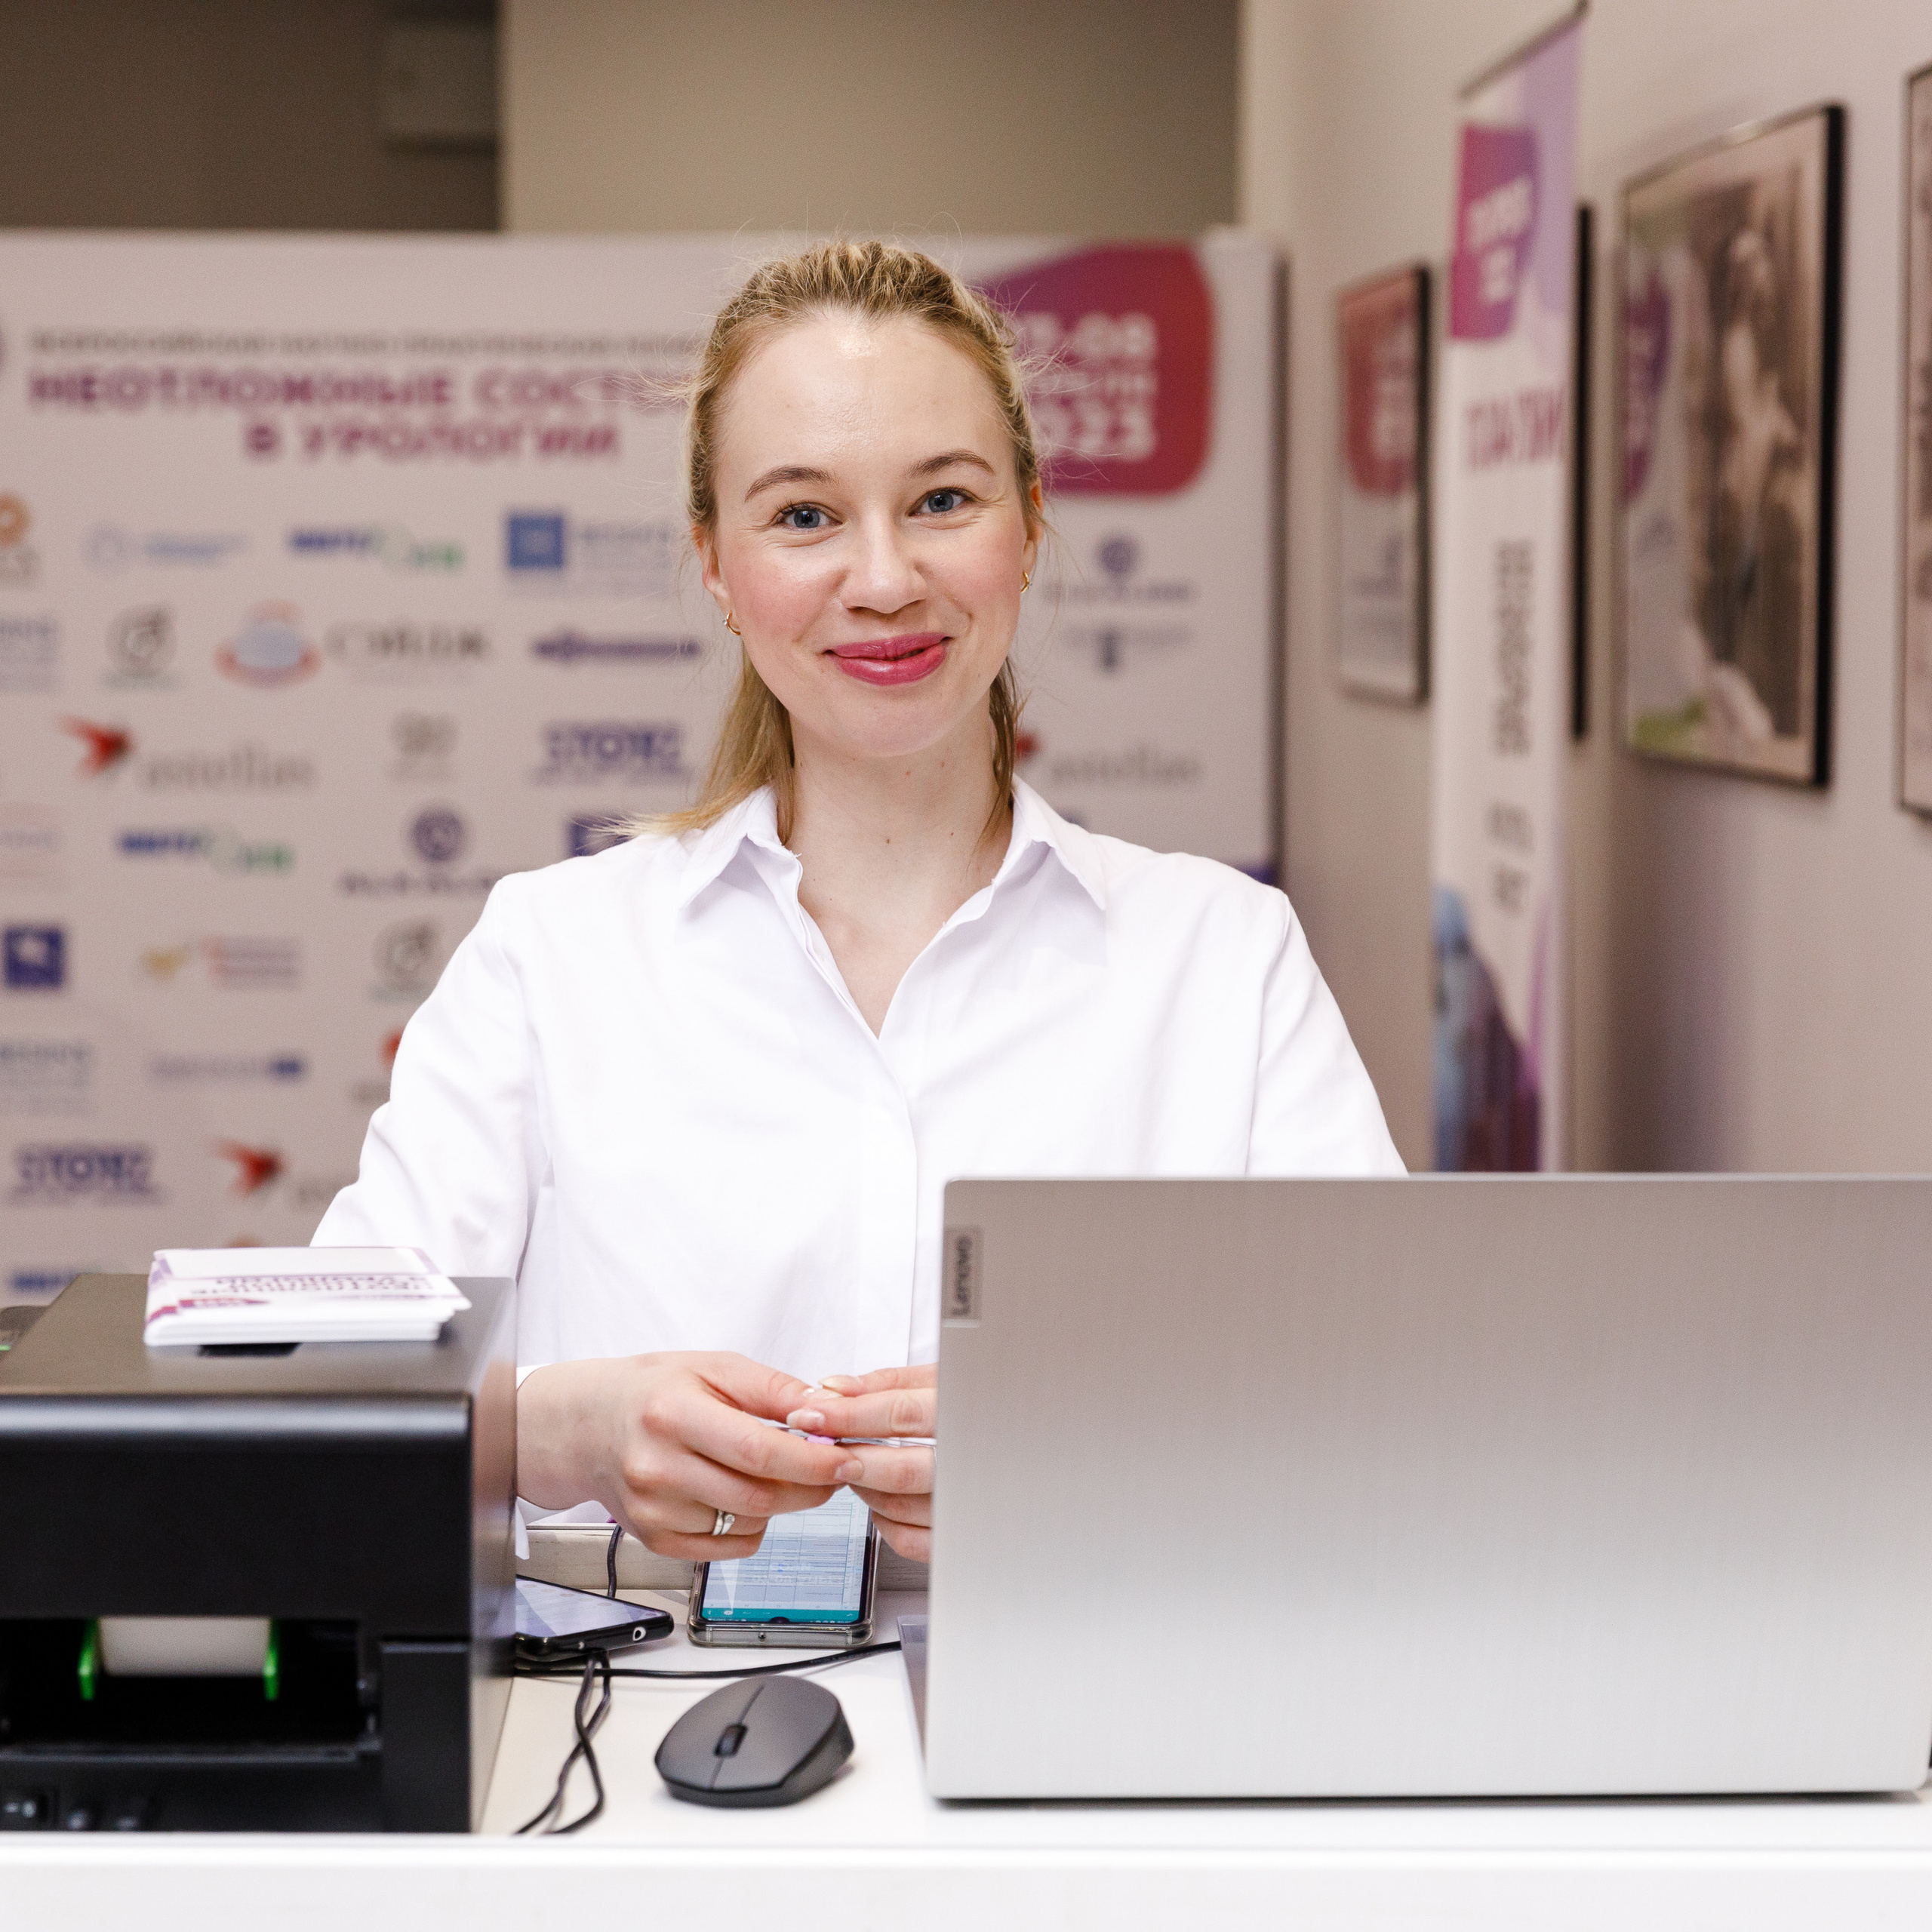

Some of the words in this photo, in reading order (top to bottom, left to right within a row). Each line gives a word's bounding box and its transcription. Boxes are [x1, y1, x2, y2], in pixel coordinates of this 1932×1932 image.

[29, 368, 457, 410] НЕОТЛОЖНЫЕ
[246, 421, 281, 457] В
[302, 420, 620, 459] УРОЛОГИИ
[951, 1235, 972, 1316] Lenovo
